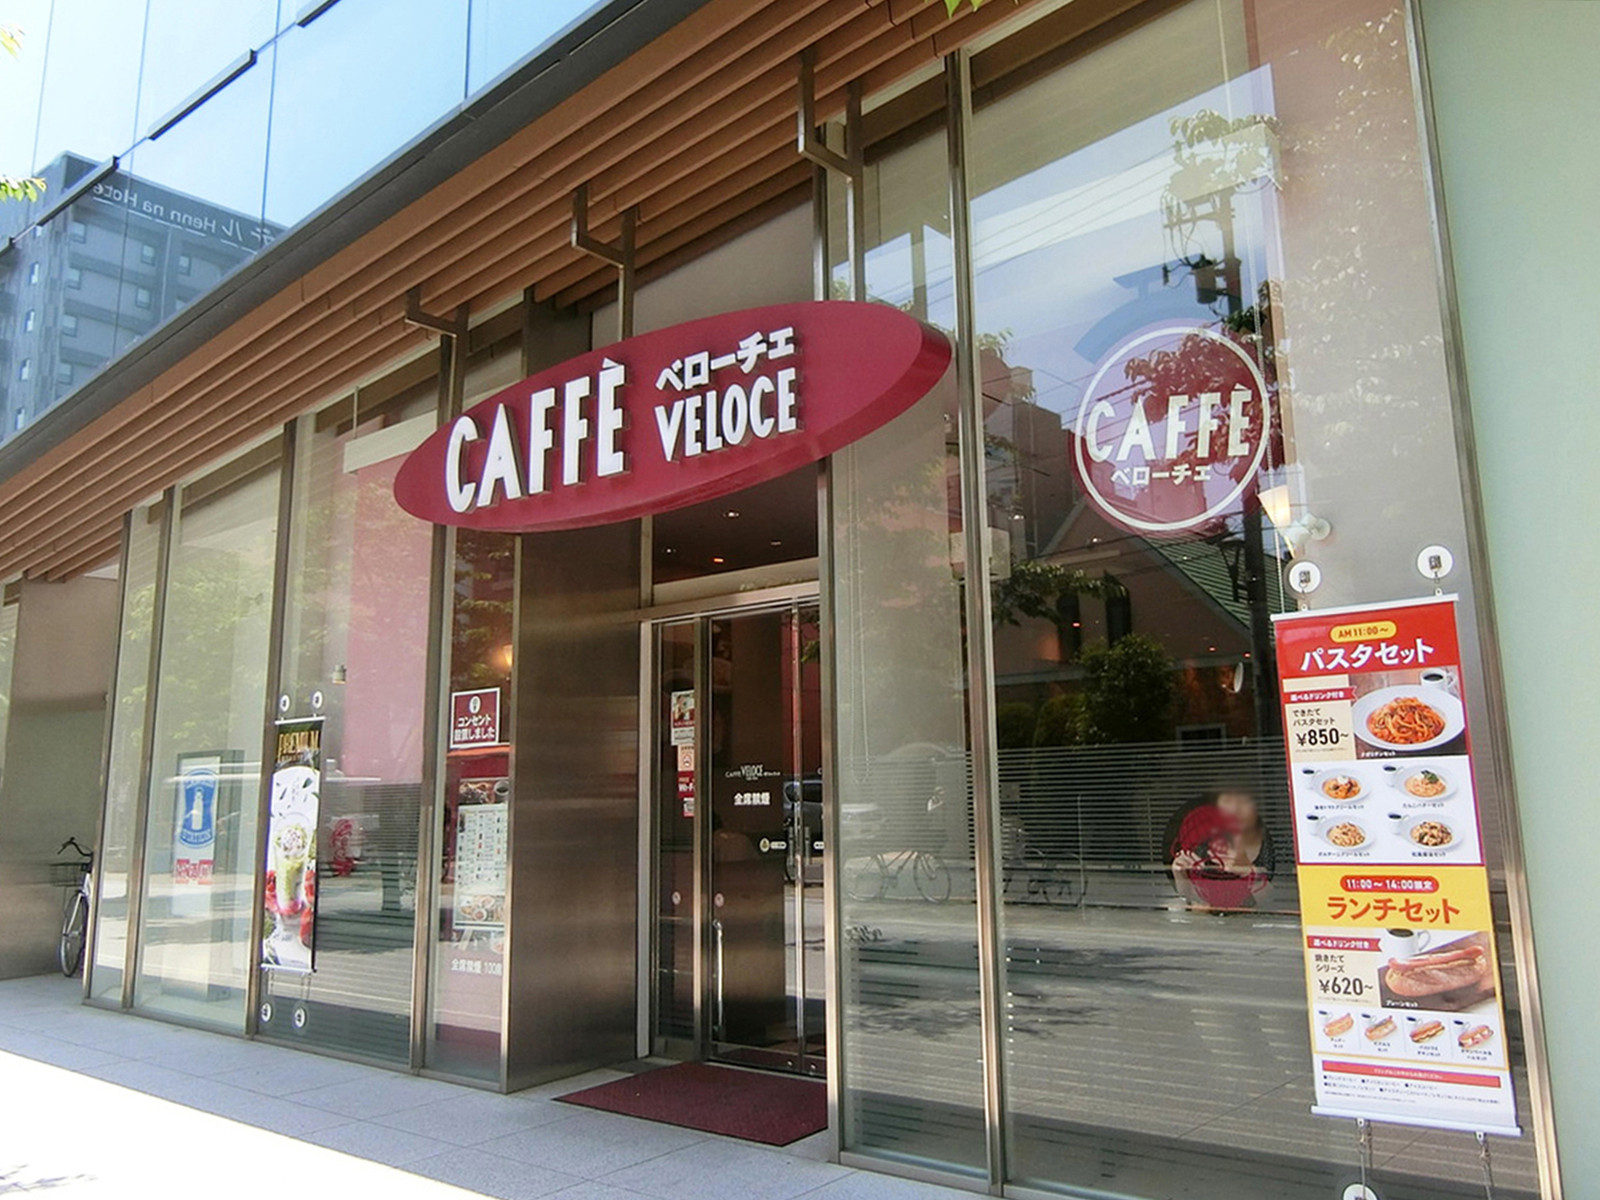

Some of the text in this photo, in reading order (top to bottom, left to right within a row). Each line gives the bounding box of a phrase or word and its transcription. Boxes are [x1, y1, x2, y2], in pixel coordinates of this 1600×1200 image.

[445, 357, 797, 514] CAFFÈ VELOCE
[1085, 382, 1253, 463] CAFFÈ
[1300, 638, 1435, 672] パスタセット
[457, 713, 493, 727] コンセント
[1292, 708, 1321, 718] できたて
[1326, 896, 1461, 925] ランチセット
[1315, 963, 1346, 974] シリーズ
